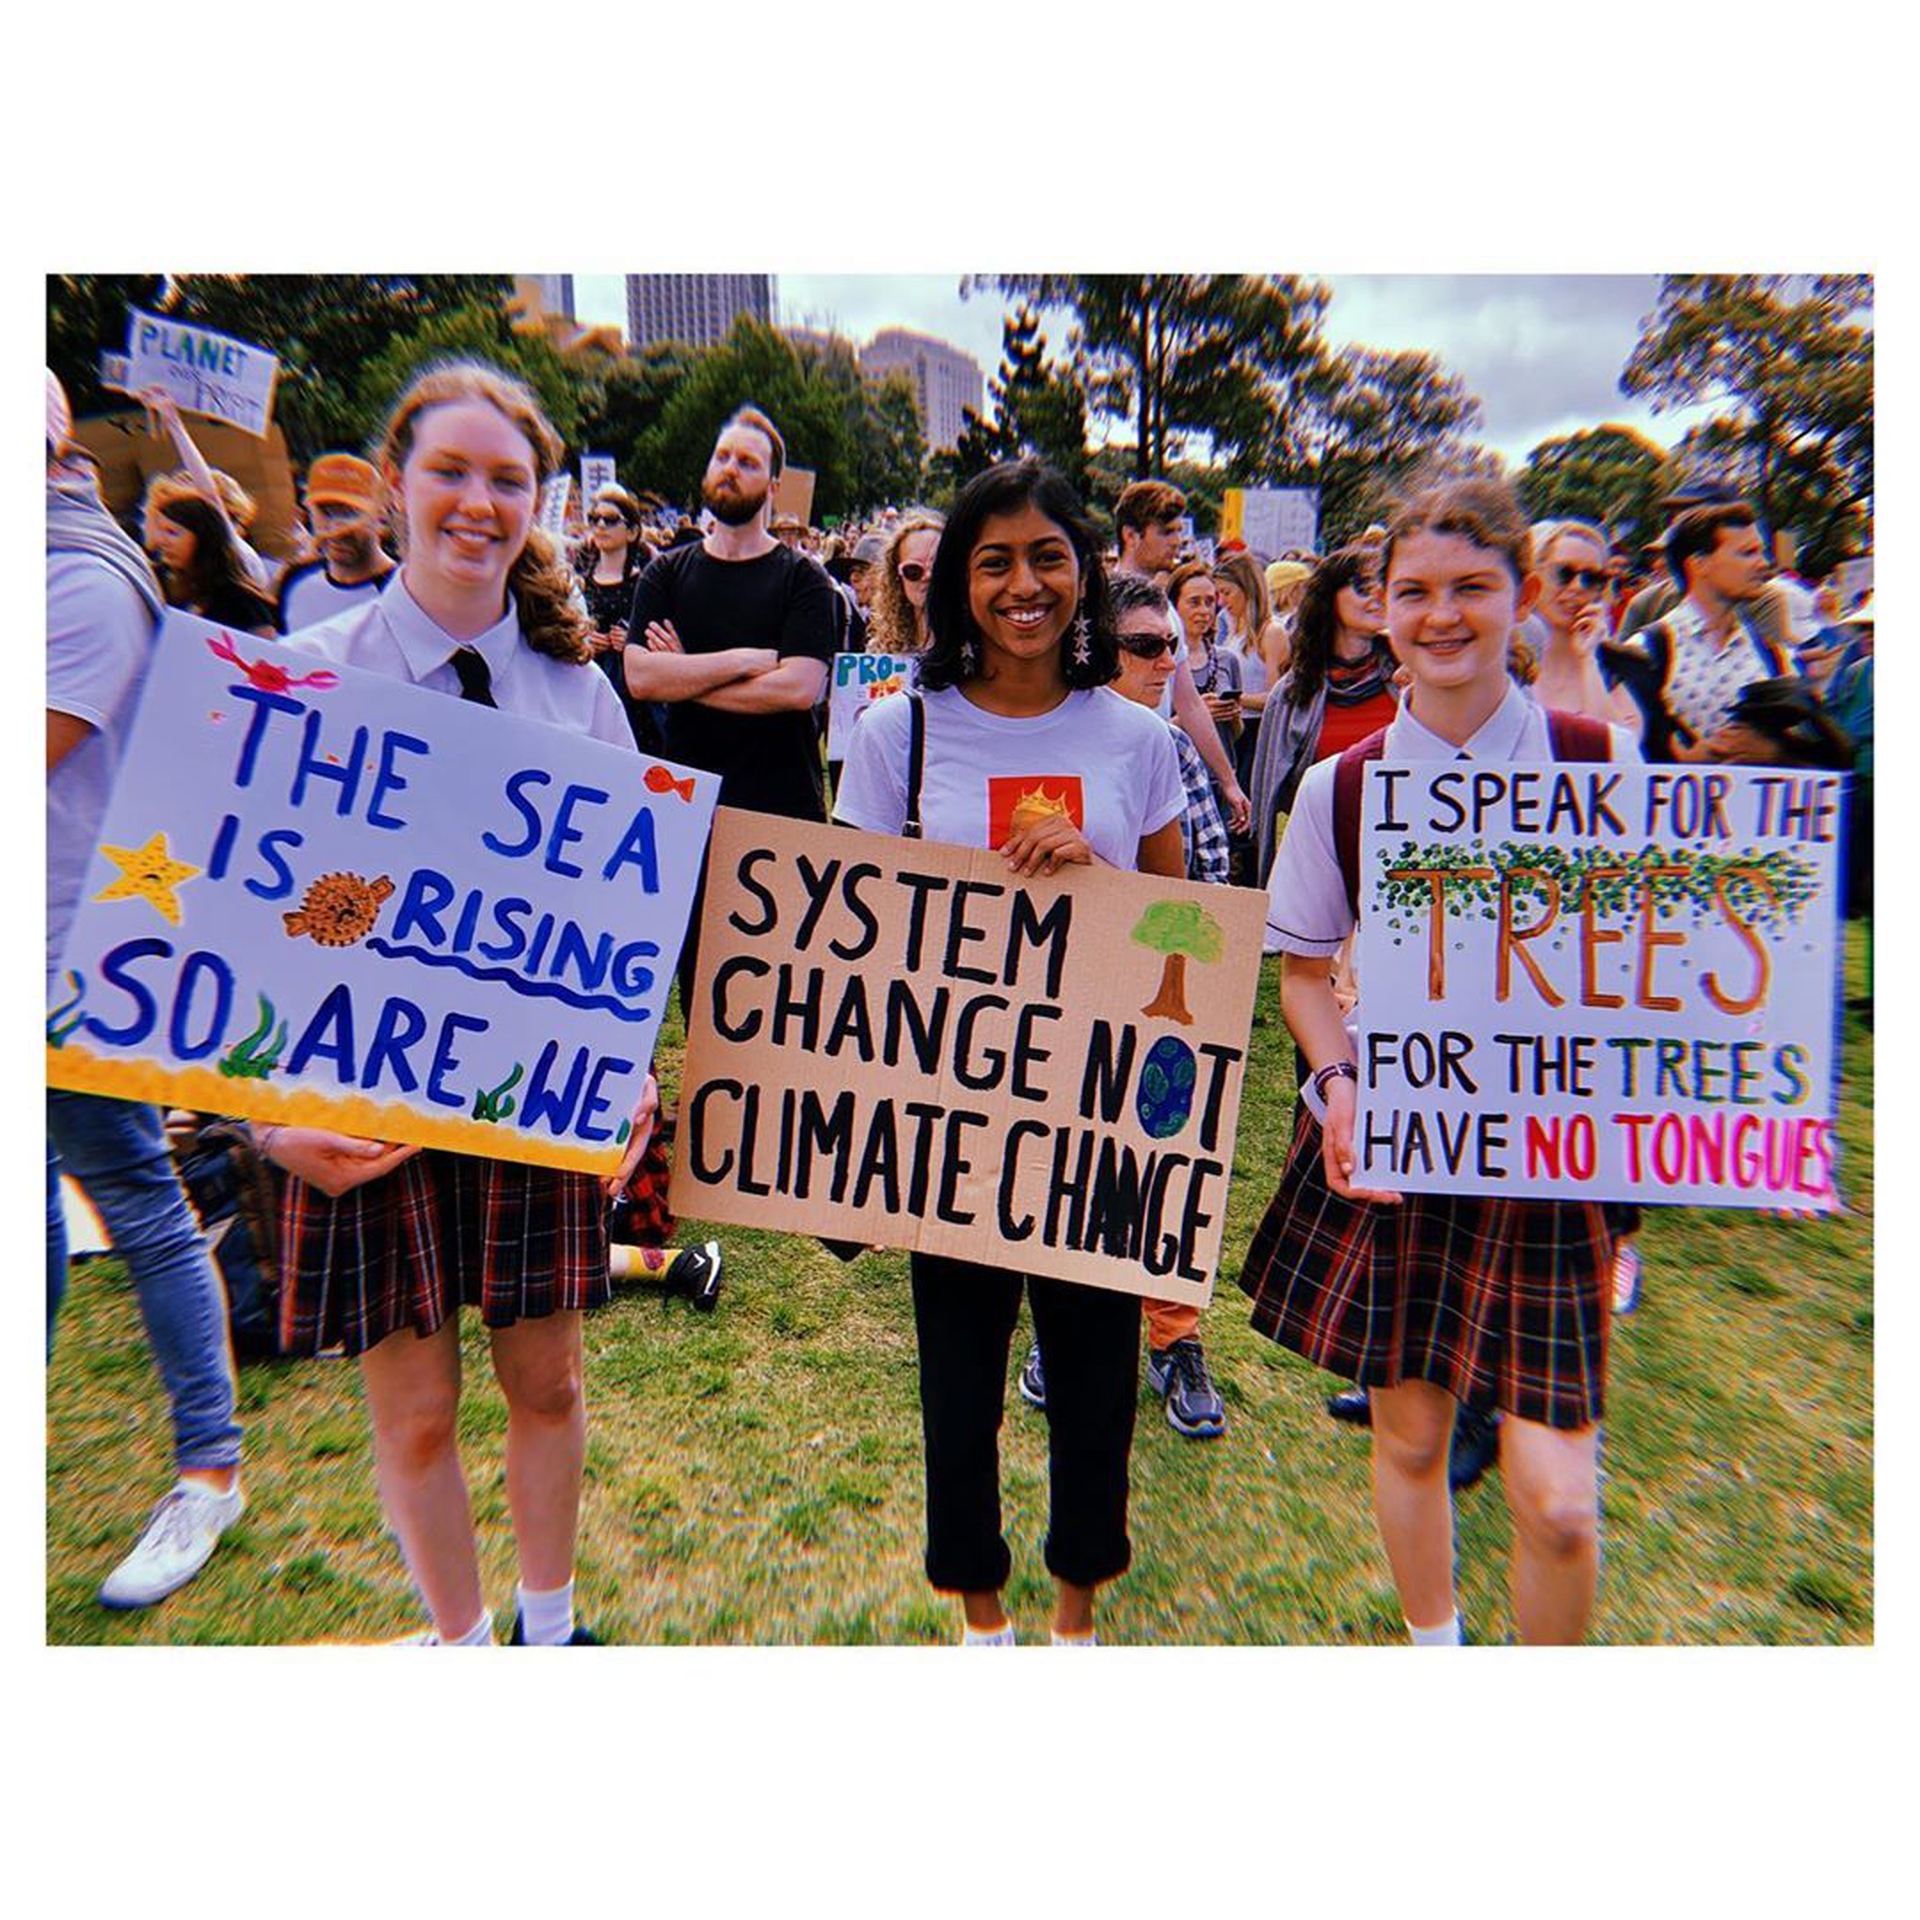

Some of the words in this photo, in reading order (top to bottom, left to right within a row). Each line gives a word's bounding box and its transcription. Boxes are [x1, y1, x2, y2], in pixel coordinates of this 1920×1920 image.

[139, 322, 248, 378] PLANET
[836, 655, 907, 687] PRO-
[228, 684, 430, 830] THE
[482, 768, 661, 894] SEA
[1374, 769, 1411, 832] I
[1428, 771, 1627, 836] SPEAK
[1645, 773, 1733, 840] FOR
[1749, 776, 1839, 843] THE
[206, 813, 304, 901] IS
[390, 868, 661, 998] RISING
[728, 848, 1073, 999] SYSTEM
[1385, 866, 1778, 1016] TREES
[85, 936, 236, 1061] SO
[285, 982, 490, 1106] ARE
[518, 1039, 634, 1143] WE
[711, 955, 1064, 1102] CHANGE
[1079, 1018, 1244, 1152] NOT
[1367, 1031, 1478, 1095] FOR
[1493, 1033, 1597, 1097] THE
[1606, 1037, 1810, 1105] TREES
[688, 1077, 990, 1226] CLIMATE
[997, 1119, 1224, 1284] CHANGE
[1362, 1109, 1508, 1178] HAVE
[1524, 1111, 1597, 1181] NO
[1611, 1111, 1836, 1198] TONGUES
